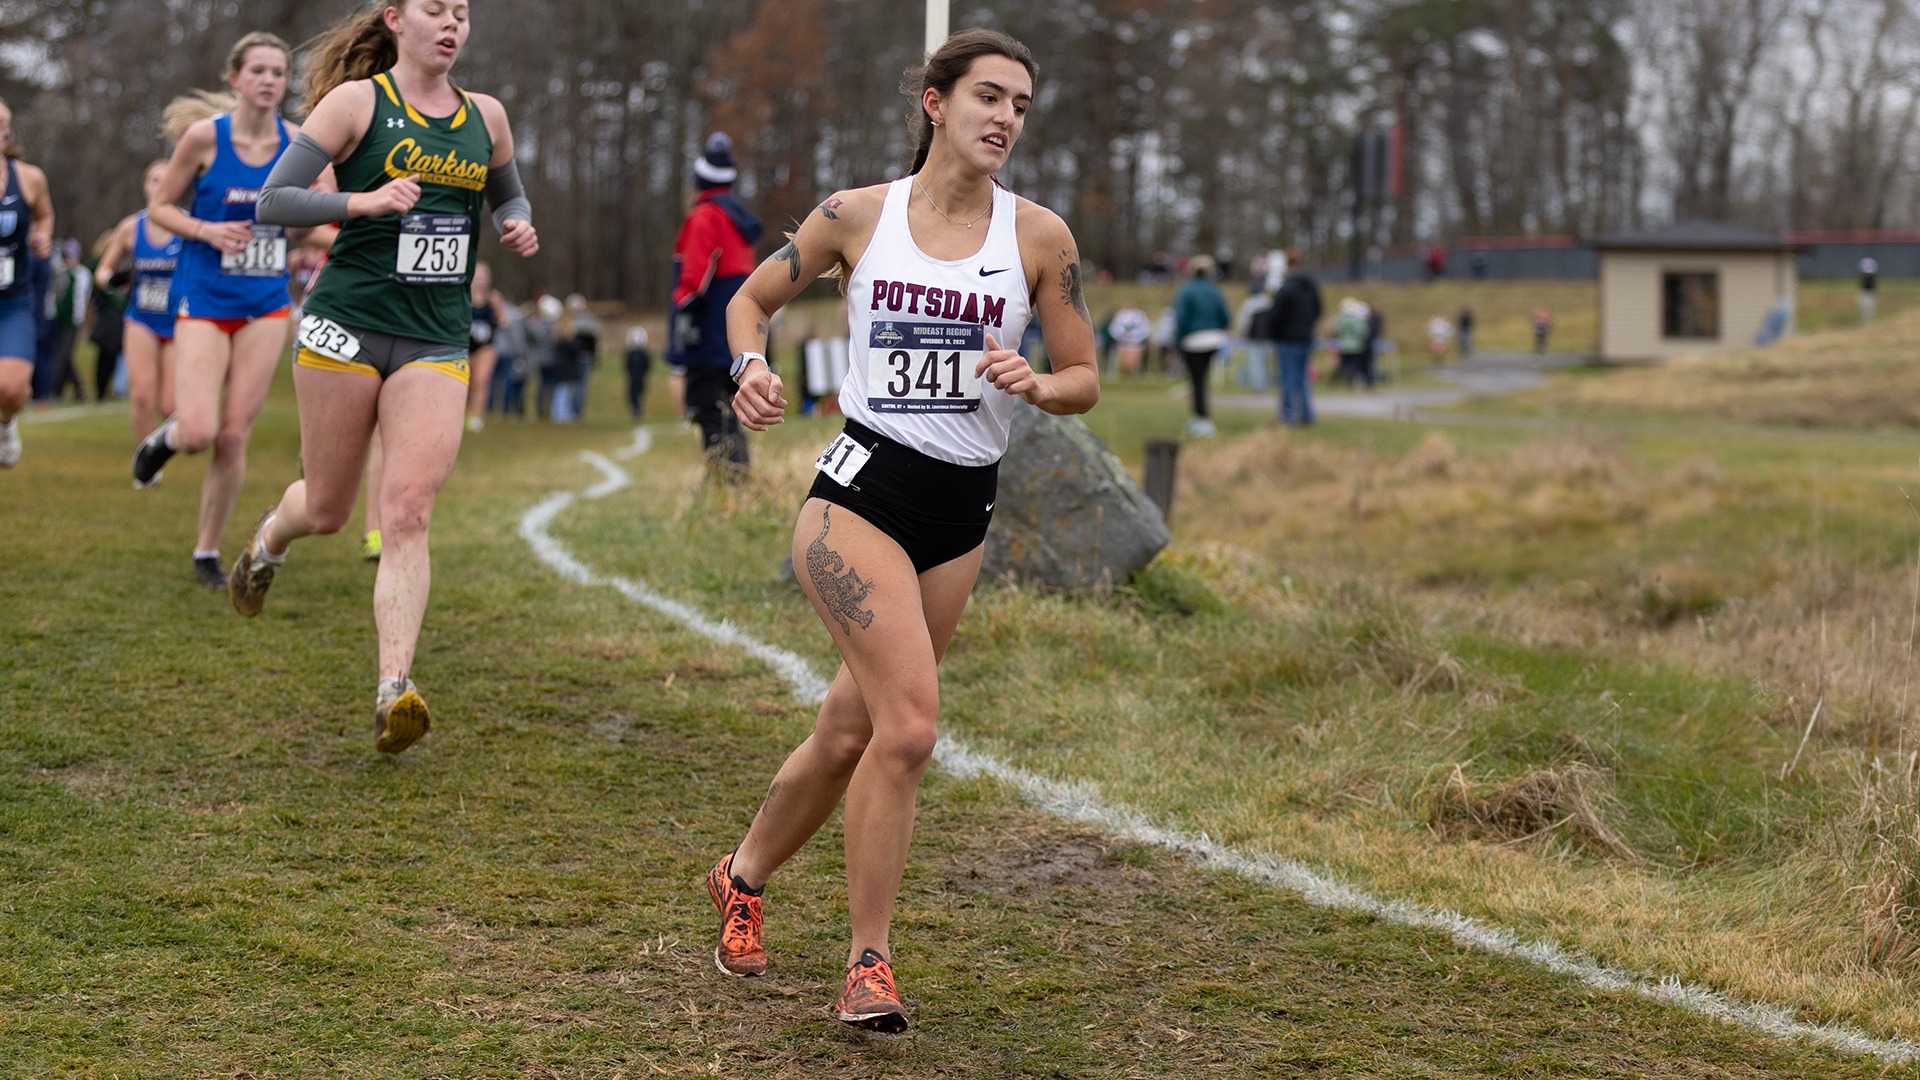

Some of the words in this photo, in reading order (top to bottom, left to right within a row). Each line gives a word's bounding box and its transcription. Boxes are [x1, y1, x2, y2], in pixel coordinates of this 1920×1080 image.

[384, 137, 488, 183] Clarkson
[412, 237, 459, 272] 253
[871, 280, 1006, 328] POTSDAM
[307, 316, 348, 353] 253
[913, 327, 944, 336] MIDEAST
[946, 328, 972, 337] REGION
[888, 350, 964, 398] 341
[817, 436, 855, 475] 41
